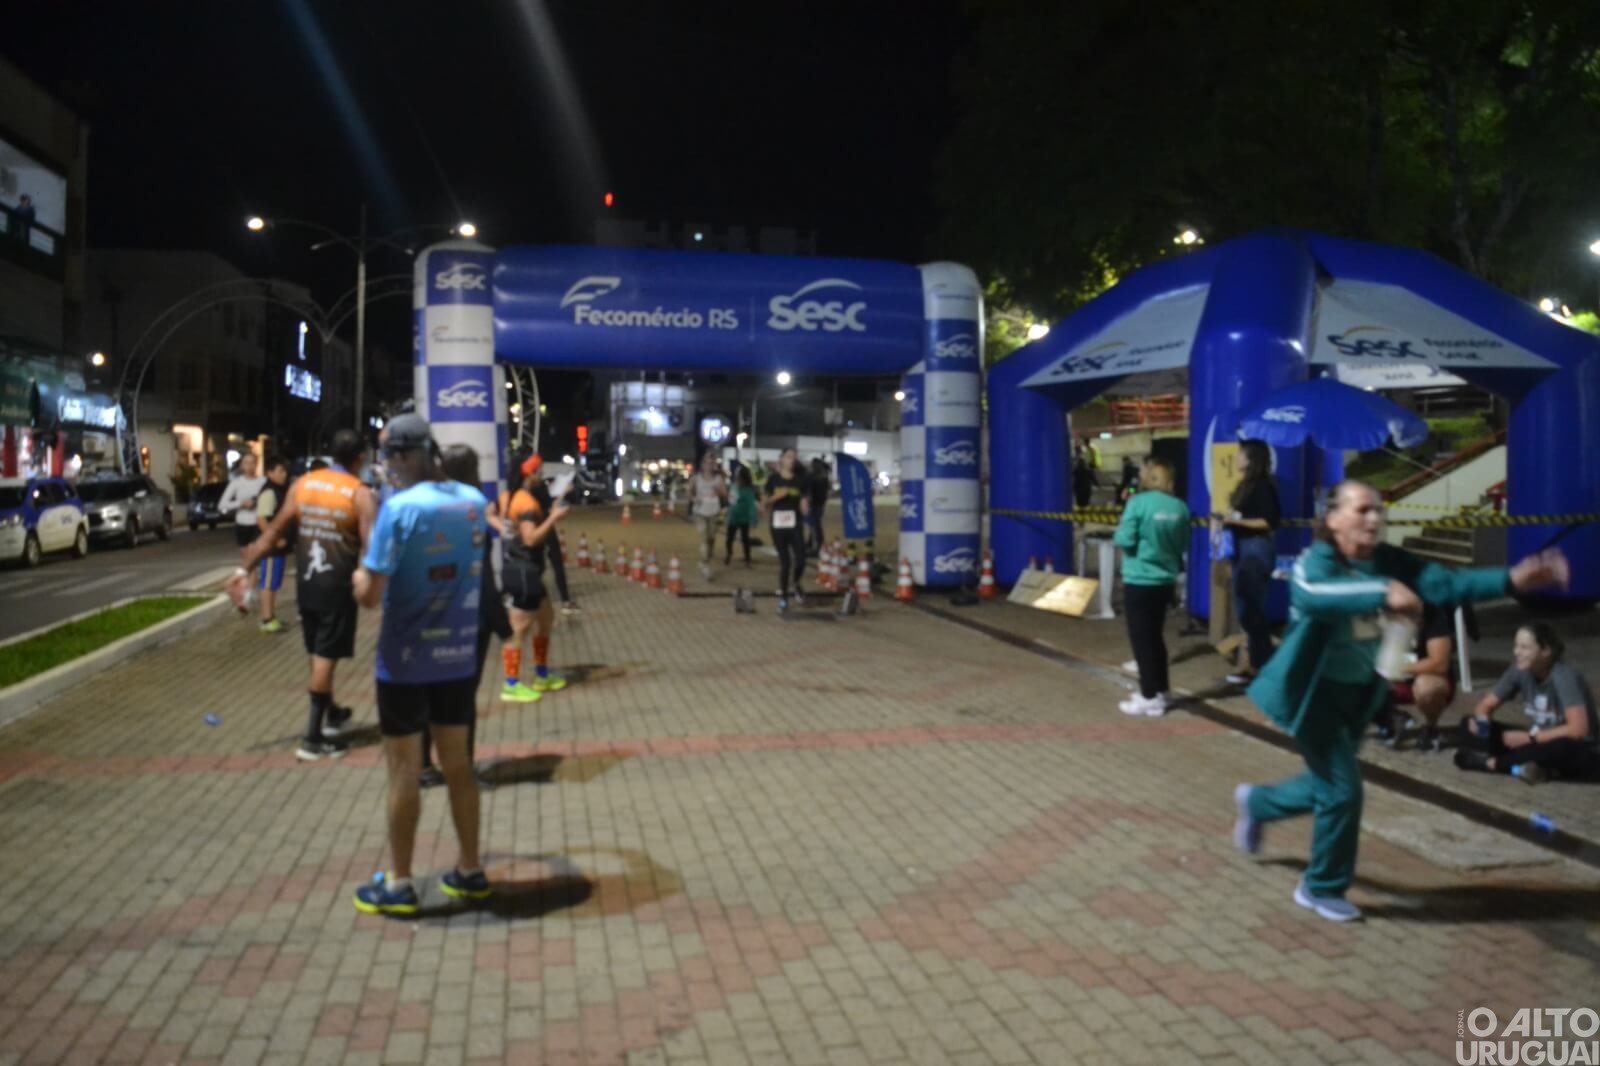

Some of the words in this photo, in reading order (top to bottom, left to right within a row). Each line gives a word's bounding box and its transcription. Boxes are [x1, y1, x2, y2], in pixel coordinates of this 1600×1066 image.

[435, 271, 486, 290] Sesc
[574, 303, 703, 328] Fecomércio
[708, 308, 739, 330] RS
[767, 294, 867, 331] Sesc
[437, 387, 489, 408] Sesc
